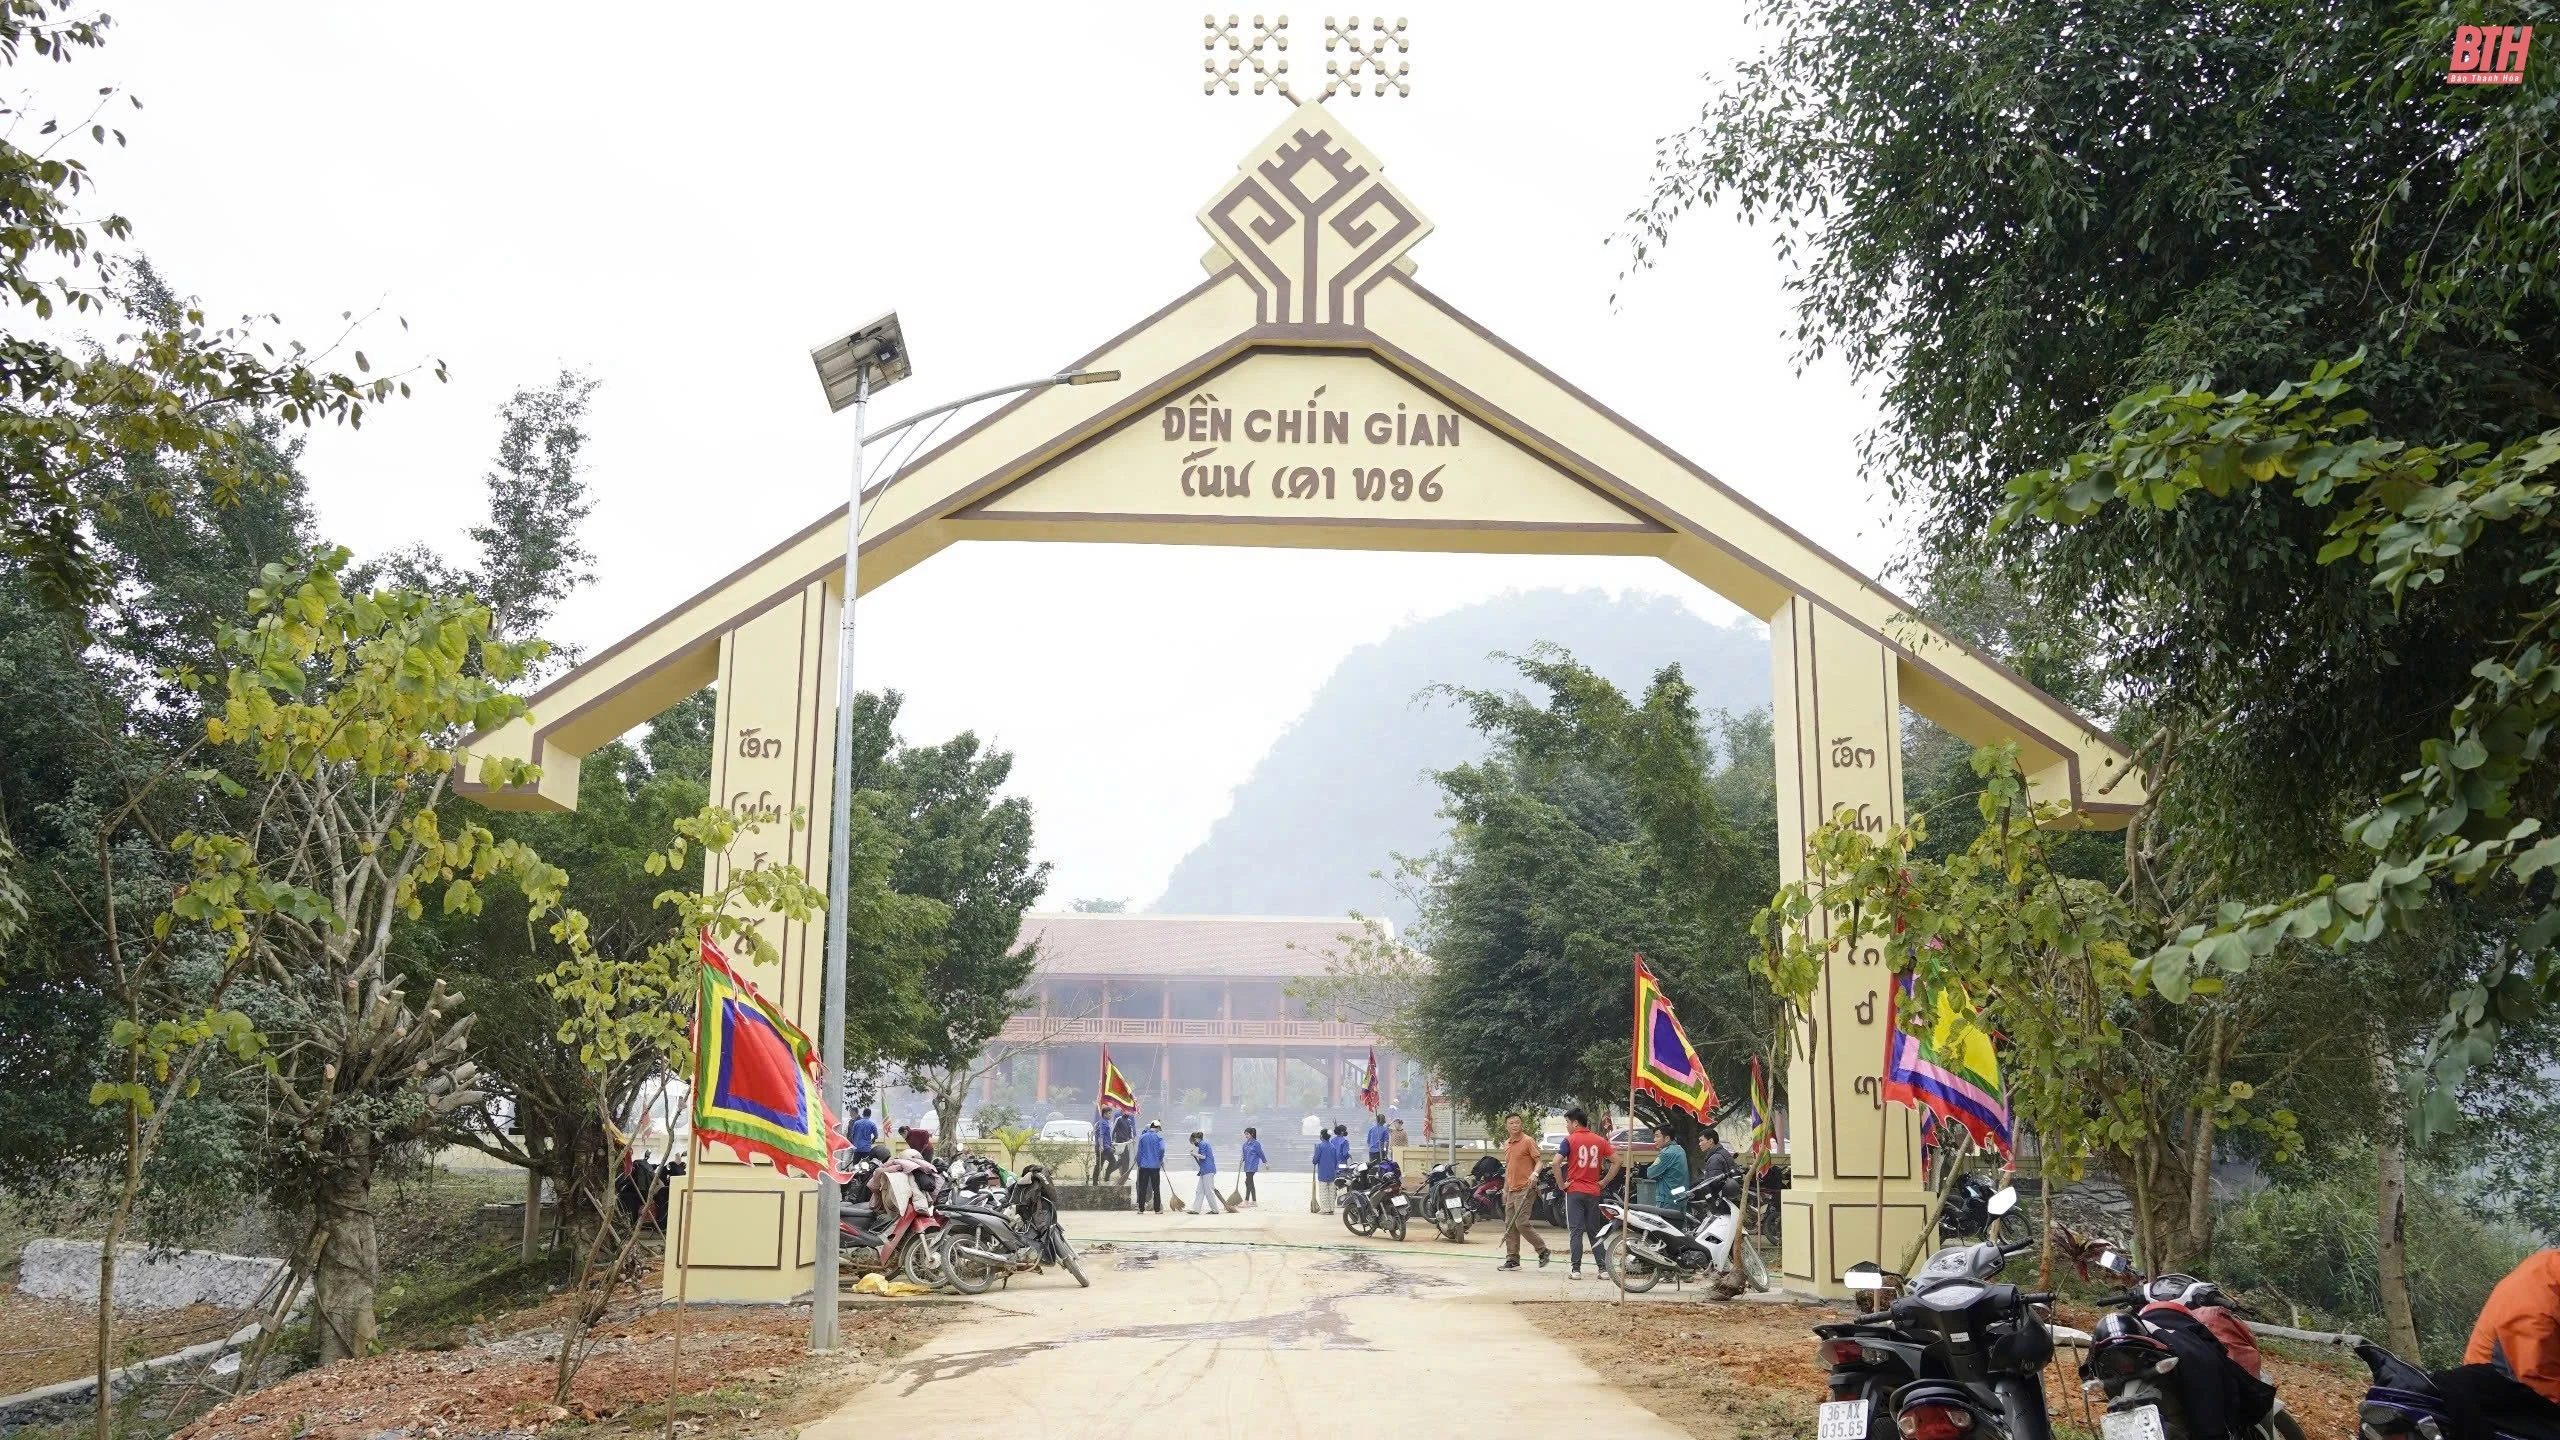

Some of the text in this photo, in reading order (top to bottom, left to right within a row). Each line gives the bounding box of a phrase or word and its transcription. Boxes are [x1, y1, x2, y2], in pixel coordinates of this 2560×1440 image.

[1162, 393, 1232, 442] ĐỀN
[1578, 1144, 1599, 1168] 92
[1821, 1420, 1864, 1439] 035.65
